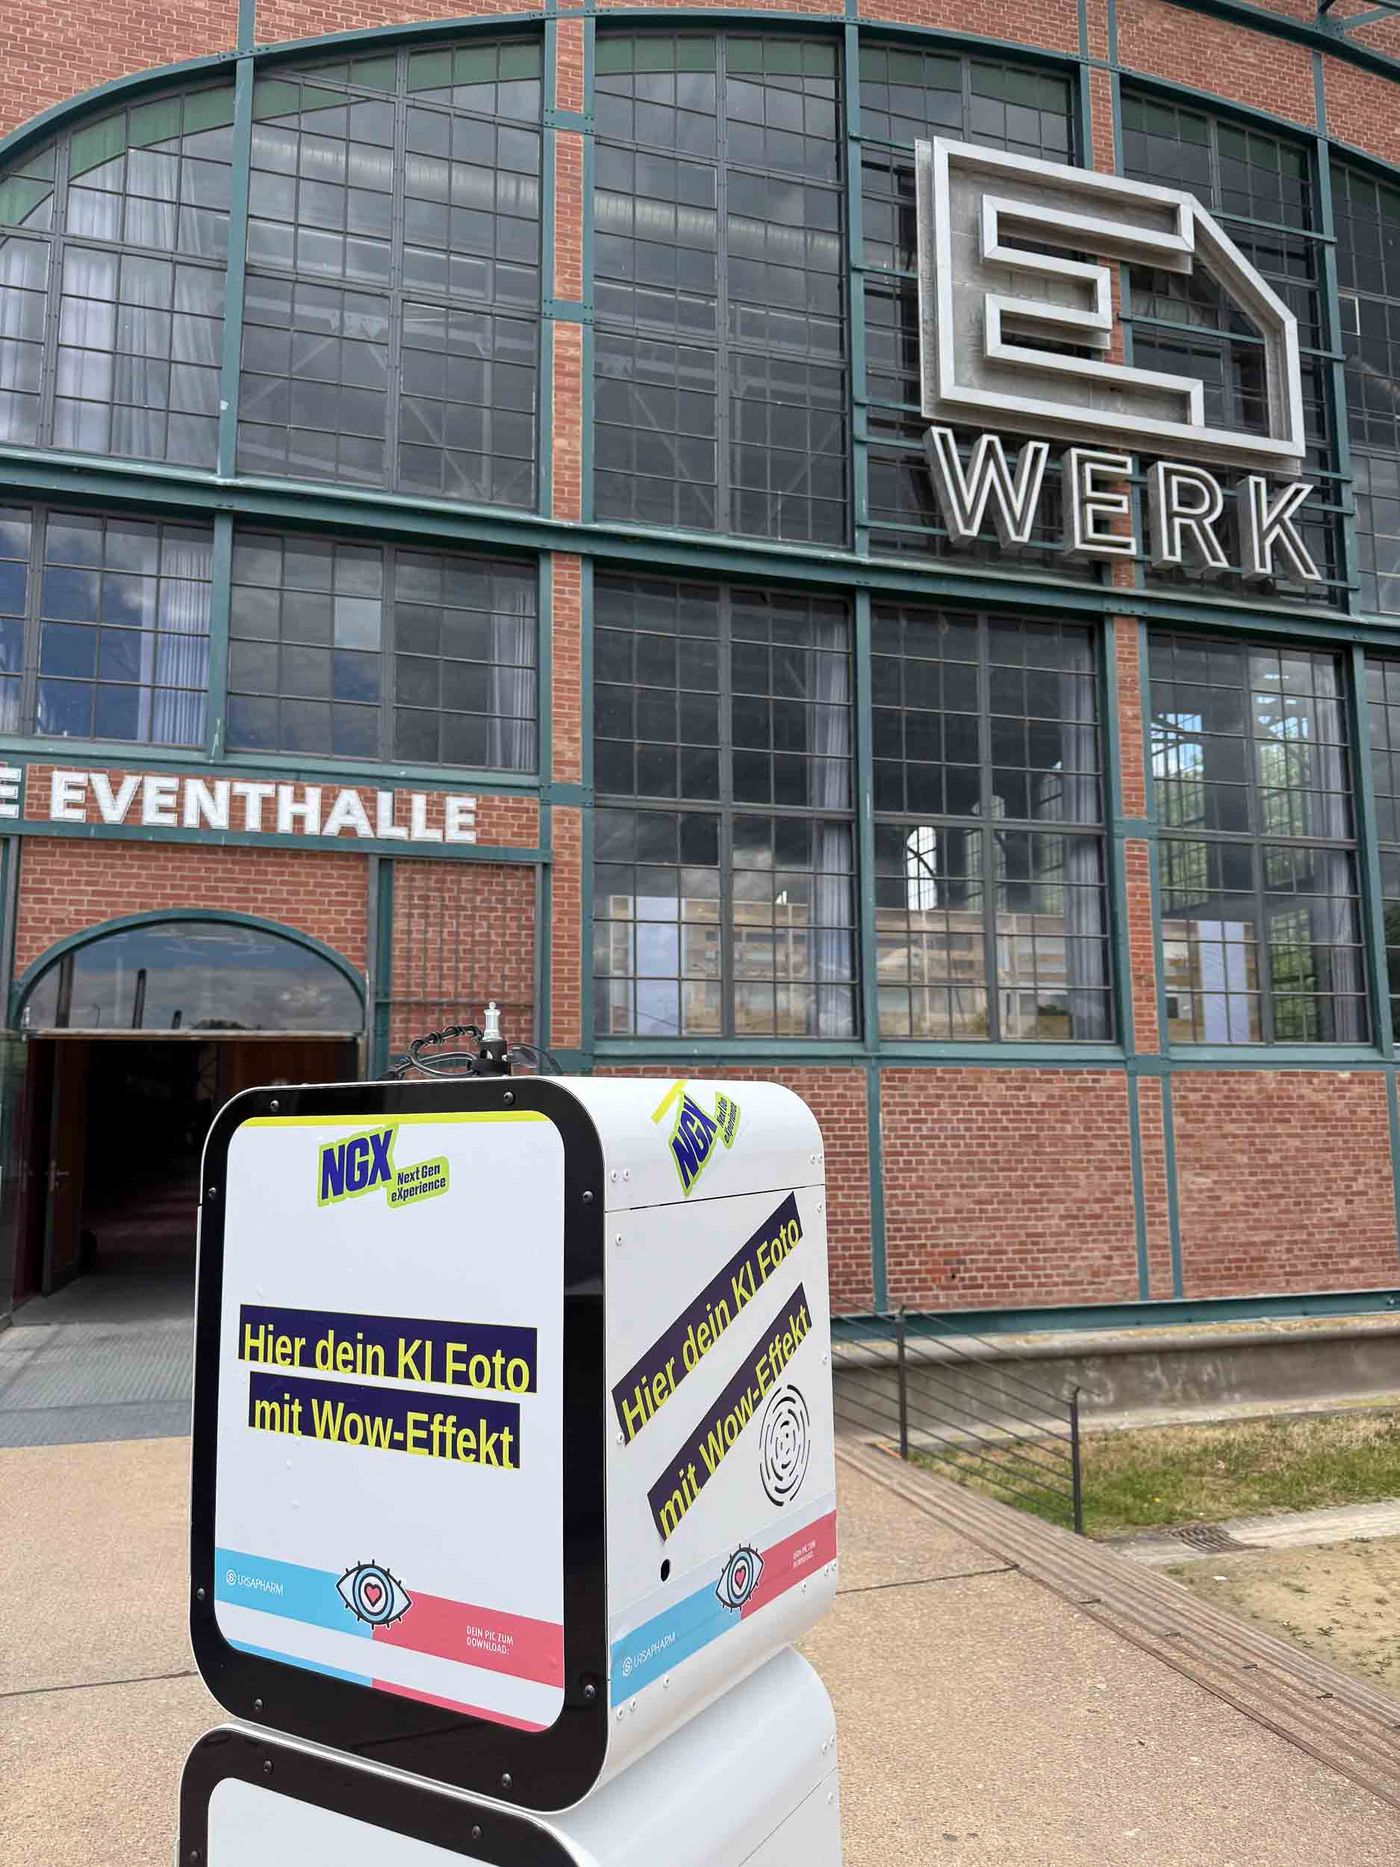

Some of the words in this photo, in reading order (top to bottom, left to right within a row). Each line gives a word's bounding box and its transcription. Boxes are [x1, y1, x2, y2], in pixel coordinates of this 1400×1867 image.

[926, 426, 1322, 582] WERK
[50, 770, 477, 843] EVENTHALLE
[321, 1129, 393, 1200] NGX
[397, 1169, 420, 1186] Next
[421, 1164, 441, 1179] Gen
[671, 1094, 718, 1189] NGX
[391, 1177, 446, 1203] eXperience
[244, 1323, 306, 1367] Hier
[315, 1329, 385, 1378] dein
[397, 1337, 433, 1384] KI
[445, 1342, 530, 1393] Foto
[621, 1356, 675, 1441] Hier
[682, 1299, 731, 1374] dein
[731, 1260, 756, 1308] KI
[755, 1219, 799, 1284] Foto
[254, 1393, 303, 1437] mit
[311, 1398, 514, 1469] Wow-Effekt
[659, 1462, 701, 1541] mit
[698, 1304, 810, 1476] Wow-Effekt
[466, 1625, 483, 1639] DEIN
[485, 1629, 496, 1642] PIC
[497, 1632, 514, 1646] ZUM
